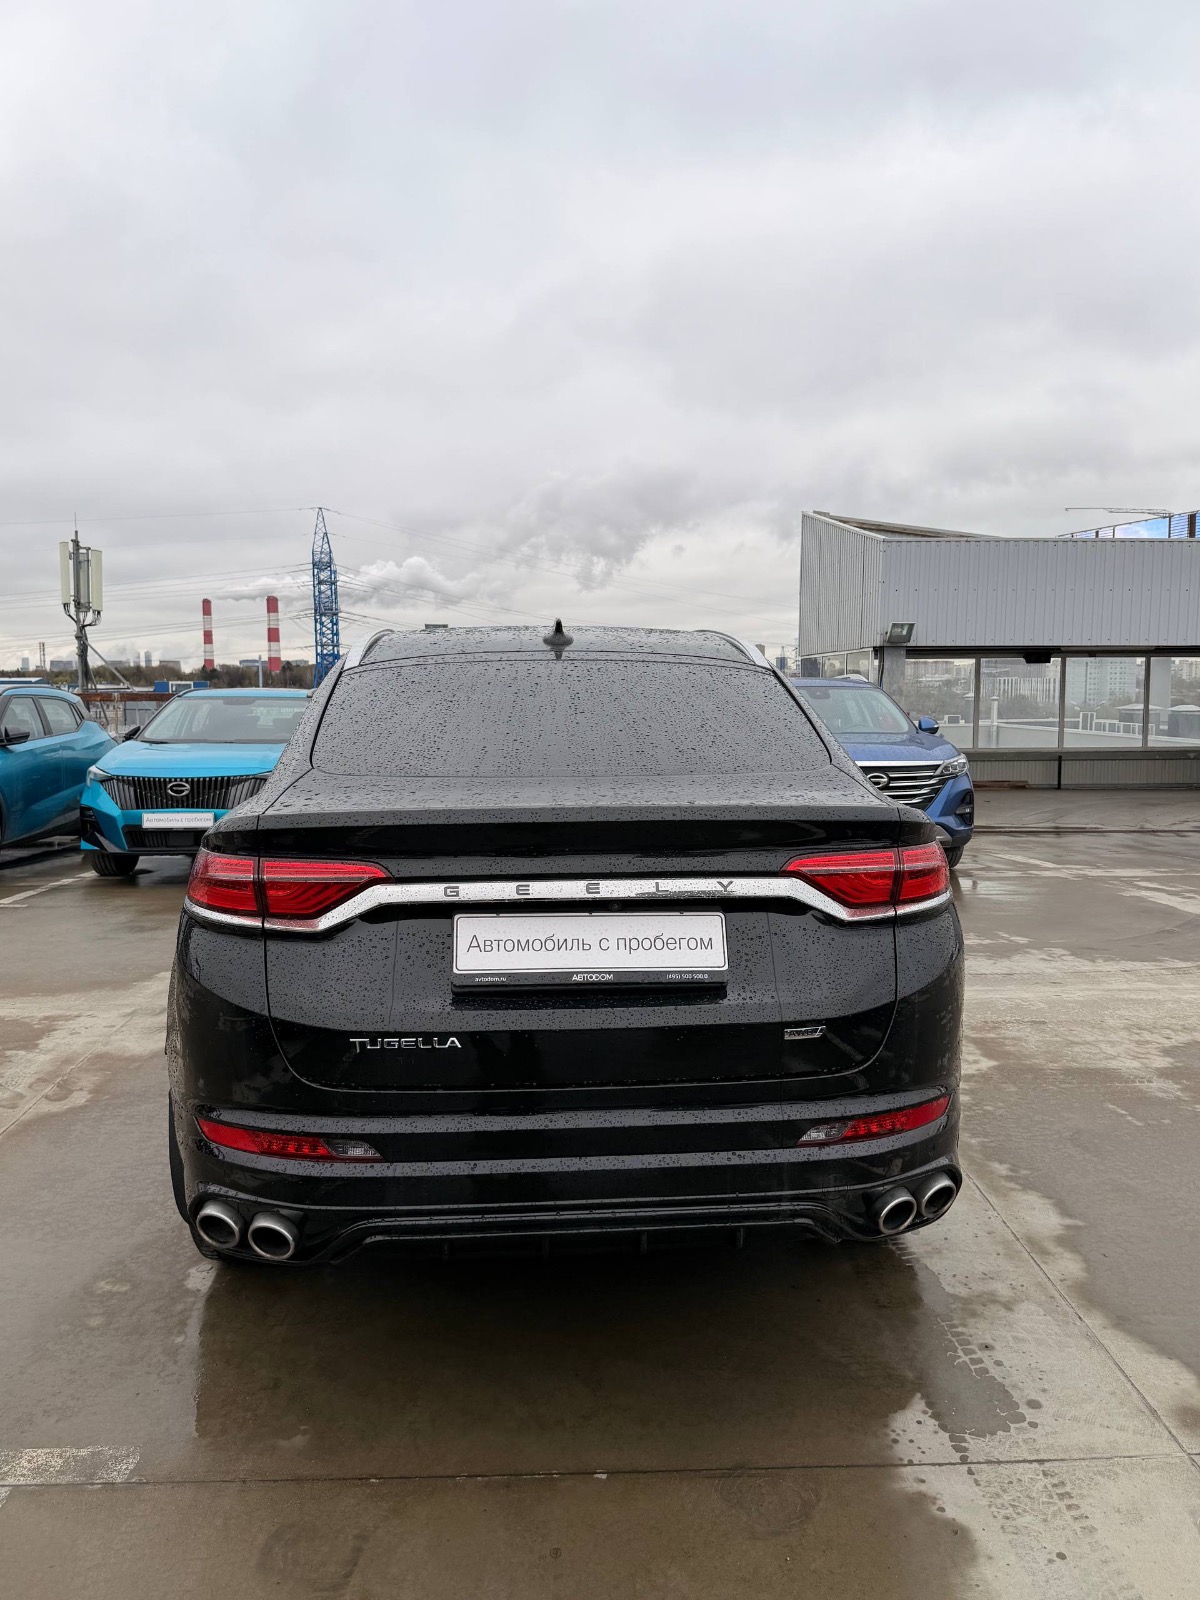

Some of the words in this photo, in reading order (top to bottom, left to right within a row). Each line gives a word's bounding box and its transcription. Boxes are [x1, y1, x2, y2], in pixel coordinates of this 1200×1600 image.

[443, 880, 734, 898] GEELY
[466, 932, 592, 953] Автомобиль
[598, 937, 611, 952] с
[615, 932, 714, 955] пробегом
[349, 1037, 462, 1053] TUGELLA
